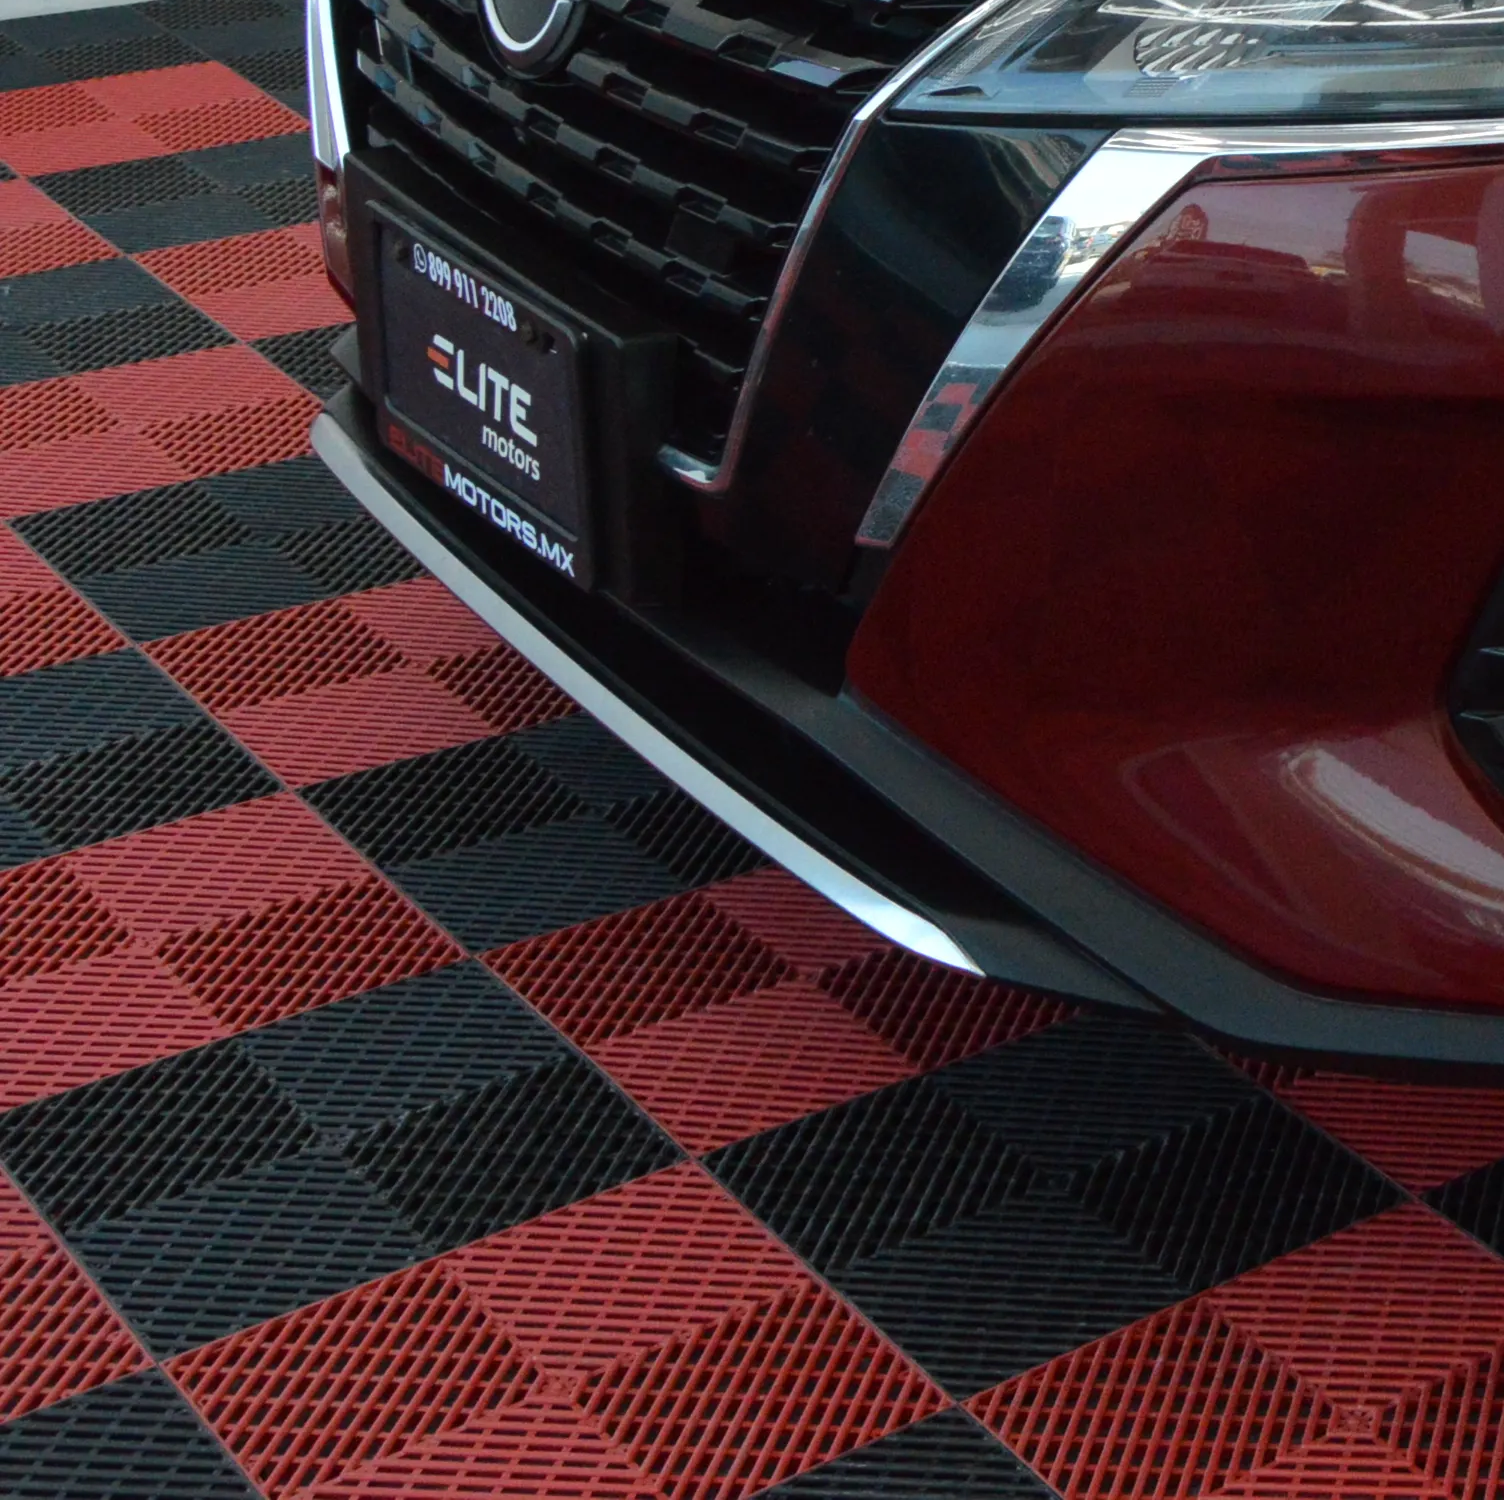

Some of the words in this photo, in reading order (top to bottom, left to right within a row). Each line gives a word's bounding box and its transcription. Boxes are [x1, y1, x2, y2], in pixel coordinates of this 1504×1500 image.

[427, 251, 451, 292] 899
[455, 267, 479, 309] 911
[480, 285, 517, 332] 2208
[427, 334, 537, 447] ELITE
[482, 424, 540, 481] motors
